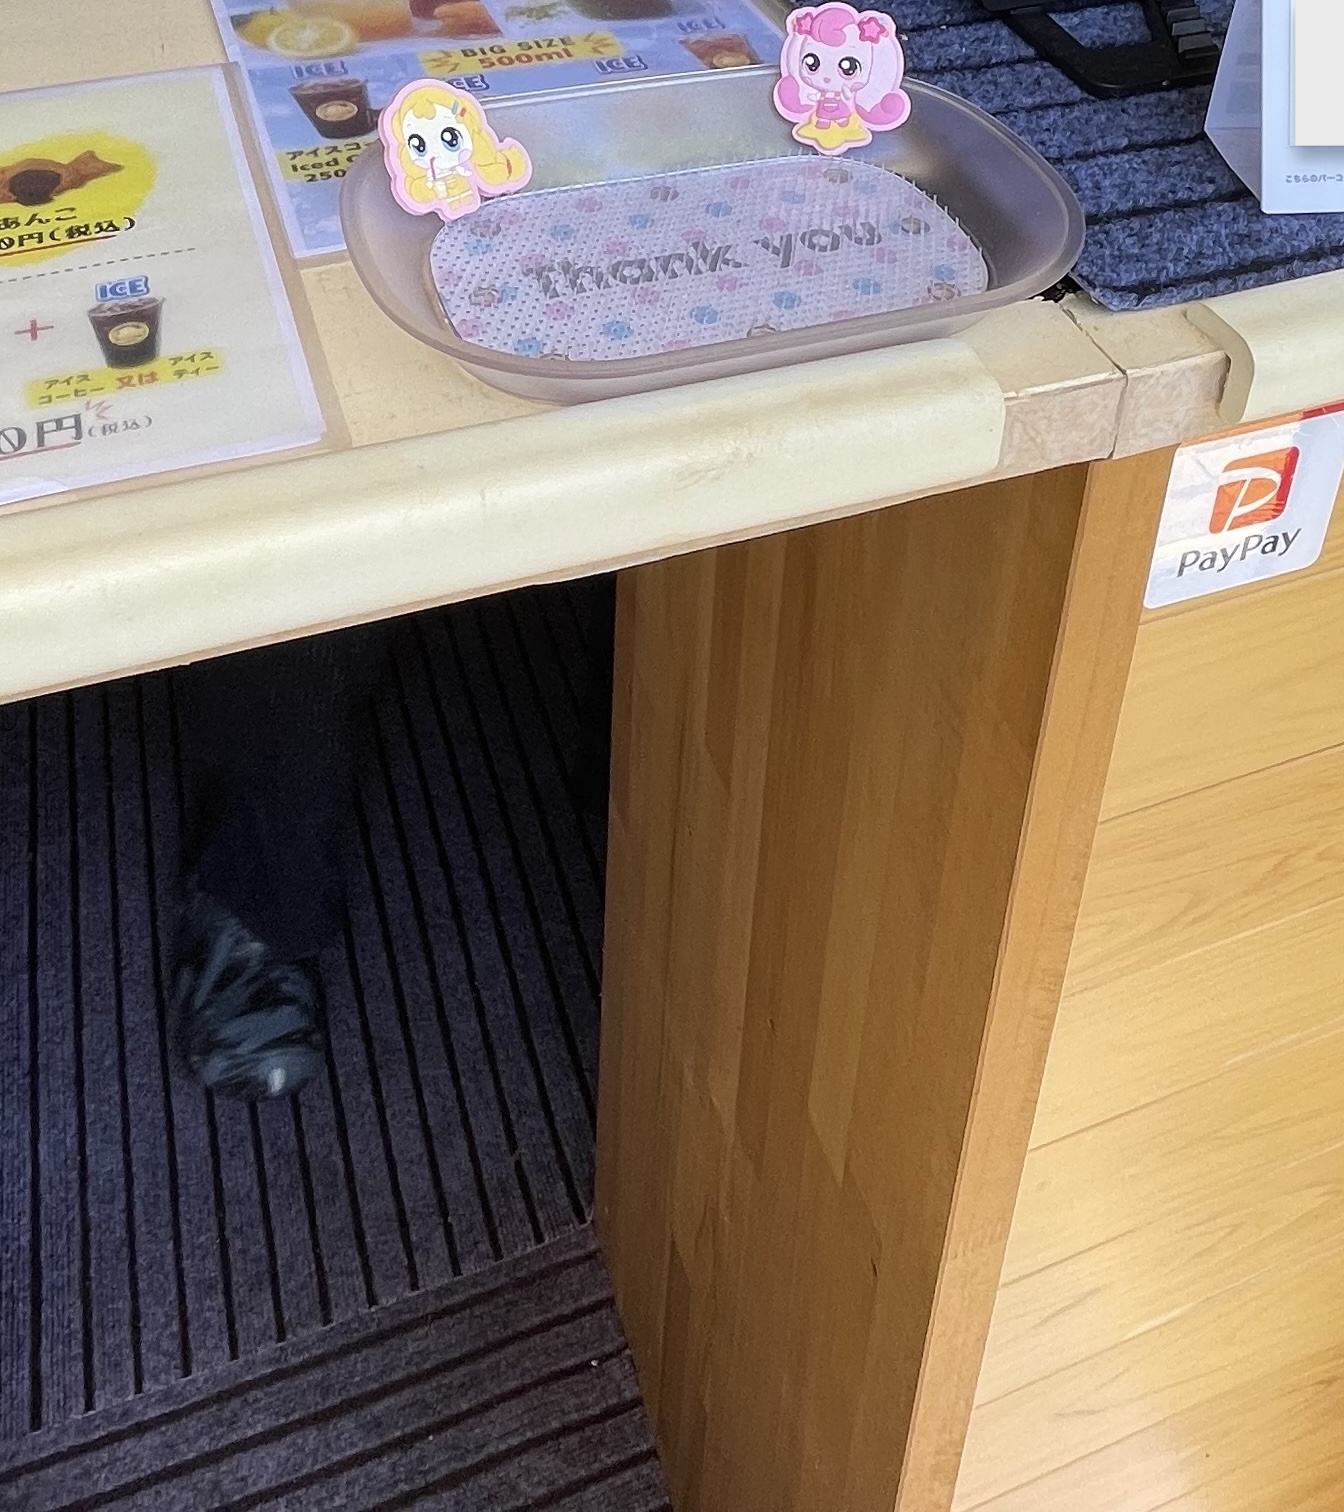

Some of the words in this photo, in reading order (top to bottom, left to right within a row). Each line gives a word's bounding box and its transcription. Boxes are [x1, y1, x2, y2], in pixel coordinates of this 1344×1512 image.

[460, 45, 507, 59] BIG
[516, 35, 577, 50] SIZE
[478, 46, 574, 70] 500ml
[594, 54, 649, 76] ICE
[752, 220, 884, 270] you
[95, 274, 150, 302] ICE
[168, 351, 215, 367] アイス
[44, 373, 91, 390] アイス
[116, 371, 159, 390] 又は
[173, 365, 220, 380] ティー
[38, 386, 105, 405] コーヒー
[1176, 528, 1302, 578] PayPay
